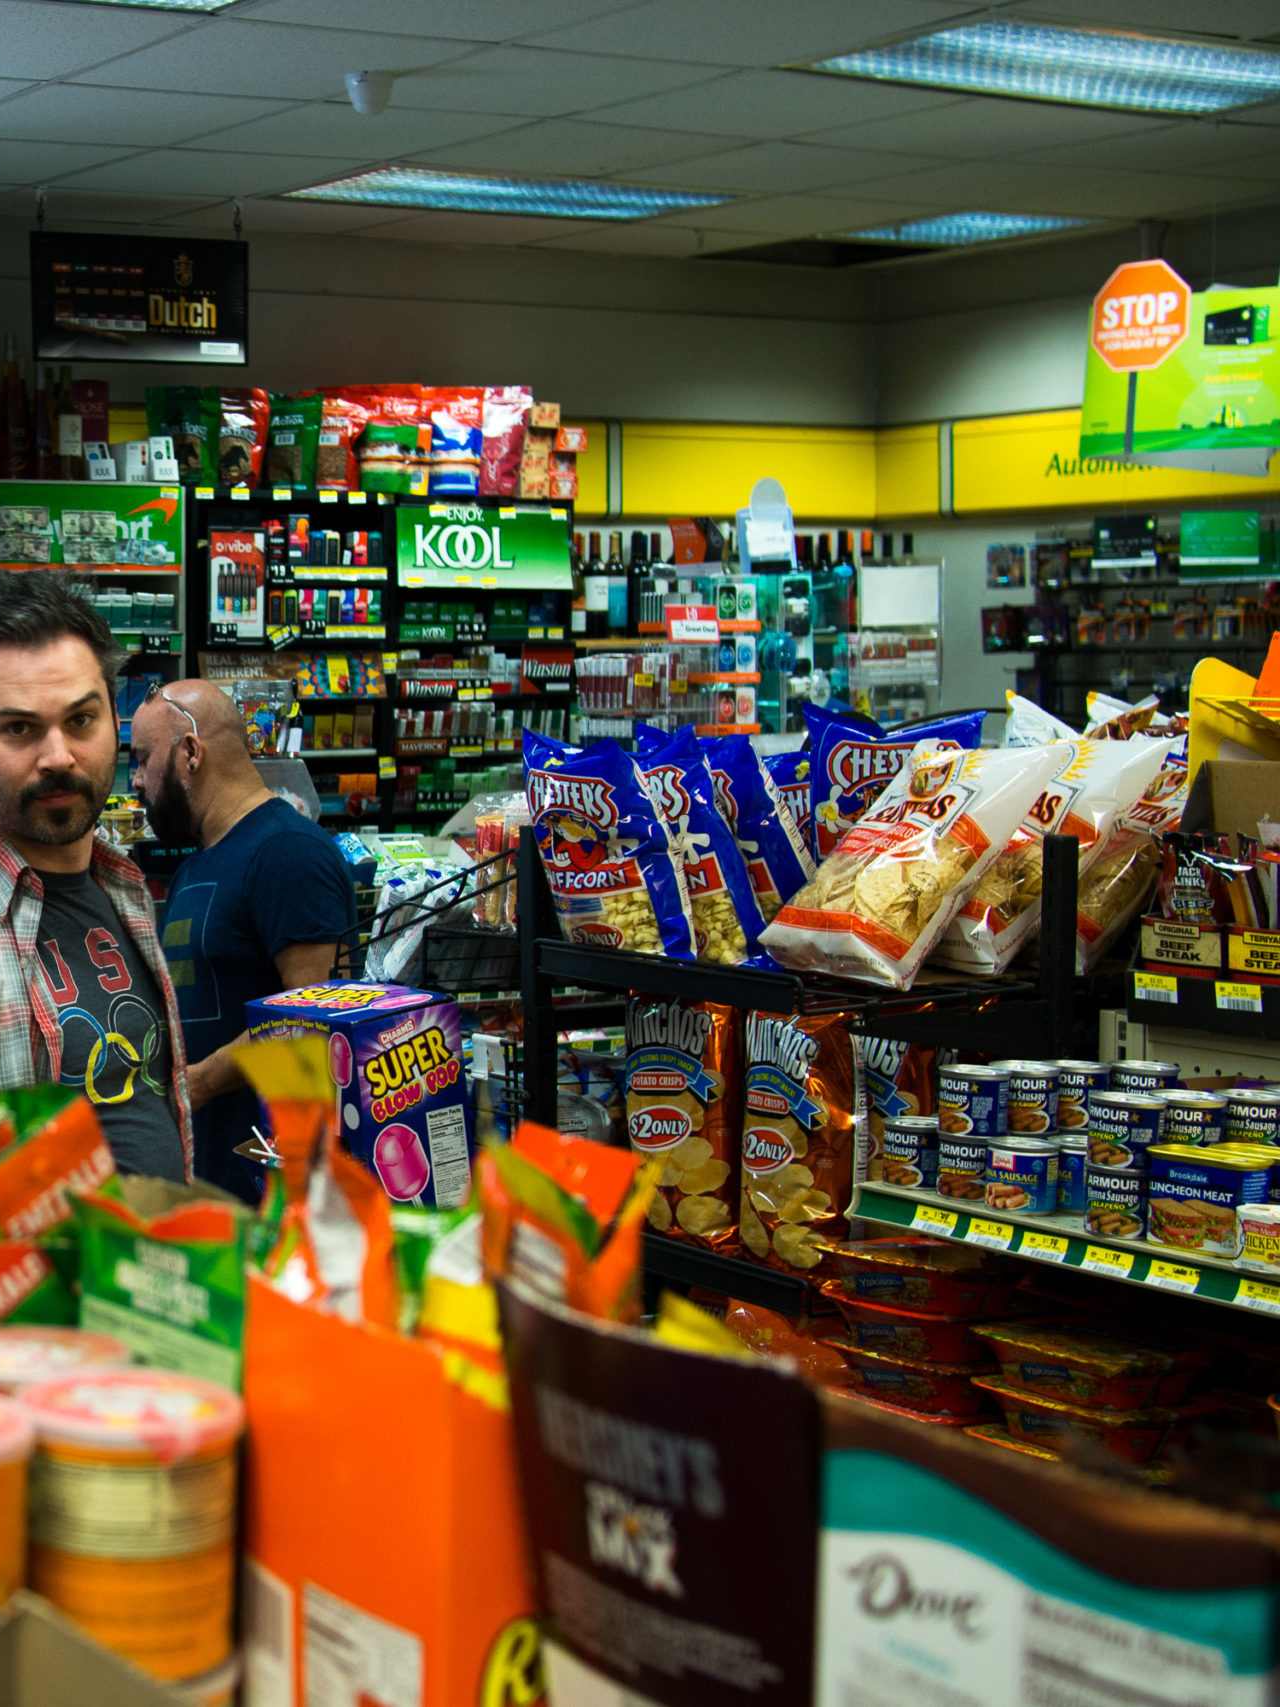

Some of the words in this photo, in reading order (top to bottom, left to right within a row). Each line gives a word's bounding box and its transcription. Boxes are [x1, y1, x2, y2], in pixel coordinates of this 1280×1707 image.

[149, 294, 218, 329] Dutch
[1102, 291, 1180, 330] STOP
[446, 507, 485, 524] ENJOY.
[228, 538, 253, 553] vibe
[412, 524, 517, 571] KOOL
[421, 627, 447, 639] KOOL
[522, 658, 572, 679] Winston
[405, 681, 454, 697] Winston
[401, 742, 444, 752] MAVERICK
[549, 868, 629, 890] UFFCORN
[1177, 866, 1202, 877] JACK
[1172, 899, 1214, 911] BEEF
[1158, 925, 1196, 936] ORIGINAL
[1159, 940, 1195, 951] BEEF
[1155, 948, 1202, 962] STEAK
[291, 987, 386, 1003] SUPER
[380, 1018, 415, 1046] CHARMS
[365, 1026, 455, 1099] SUPER
[631, 1075, 658, 1087] POTATO
[658, 1075, 684, 1087] CRISPS
[371, 1080, 423, 1124] BLOW
[425, 1058, 461, 1095] POP
[1017, 1091, 1047, 1103] Sausage
[1098, 1120, 1129, 1136] Sausage
[1245, 1120, 1277, 1135] Sausage
[955, 1157, 986, 1172] Sausage
[999, 1171, 1039, 1183] SAUSAGE
[1088, 1173, 1140, 1192] ARMOUR
[1169, 1169, 1209, 1184] Brookdale
[1106, 1189, 1139, 1206] Sausage
[1202, 1188, 1234, 1204] MEAT
[844, 1551, 985, 1643] Dove
